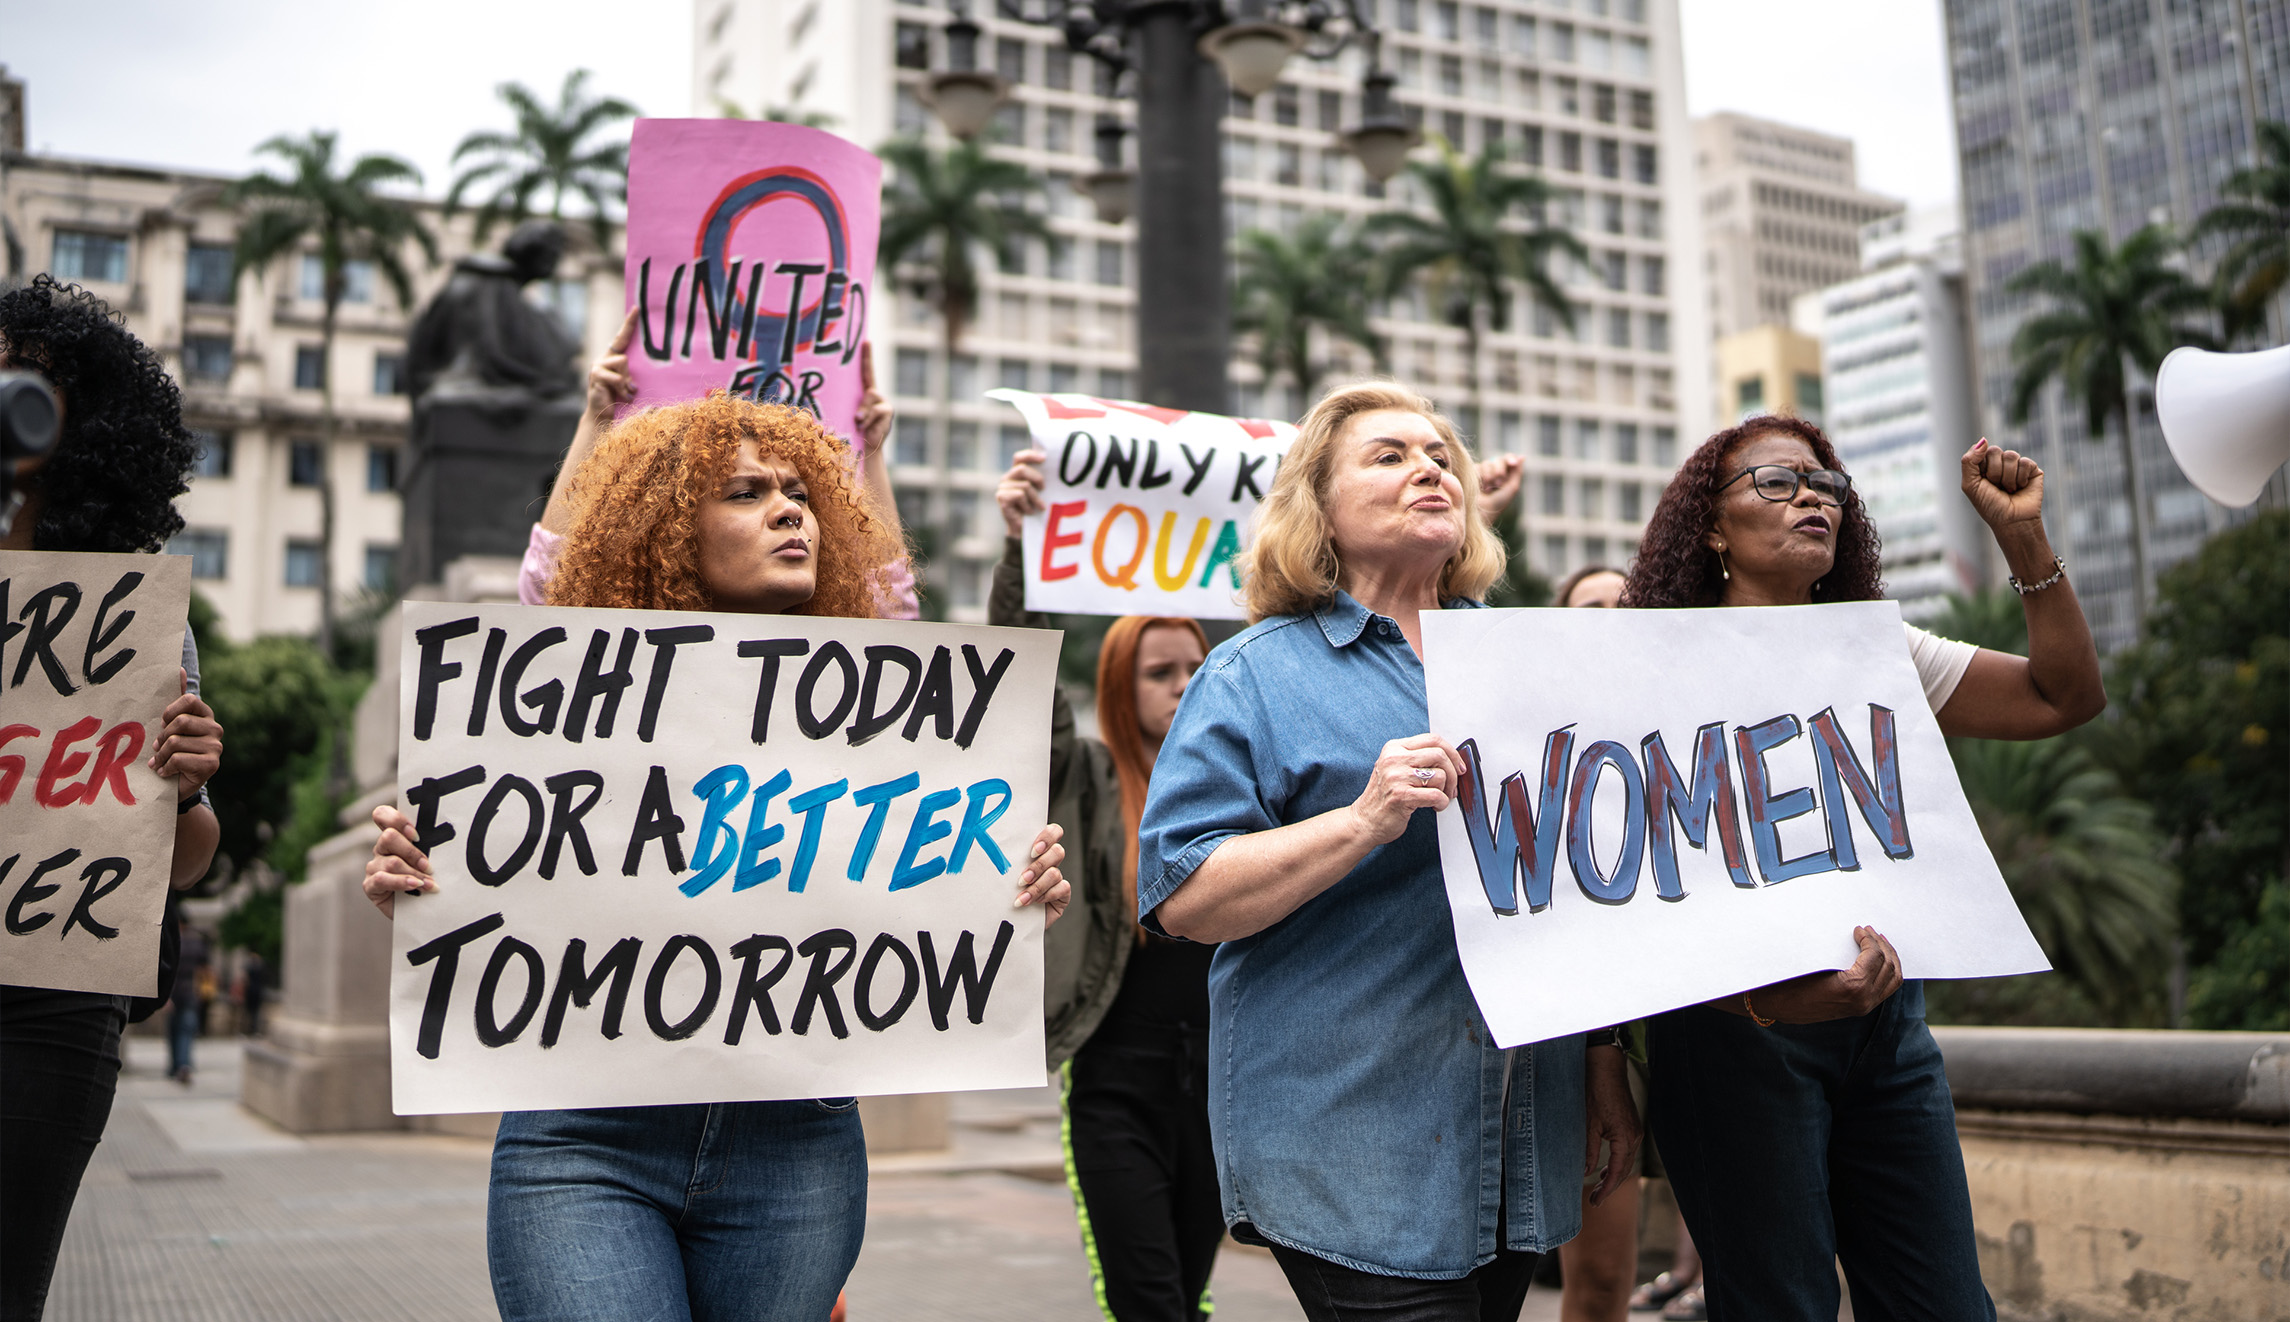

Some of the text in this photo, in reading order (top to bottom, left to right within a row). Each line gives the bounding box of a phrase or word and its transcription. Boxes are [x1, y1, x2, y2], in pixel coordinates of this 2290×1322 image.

[638, 255, 867, 366] UNITED
[728, 366, 825, 420] FOR
[1059, 431, 1217, 496] ONLY
[1040, 501, 1244, 592] EQUA
[414, 616, 1015, 750] FIGHT TODAY
[405, 764, 1013, 898] FOR A BETTER
[1457, 703, 1914, 919] WOMEN
[0, 848, 132, 942] ER
[407, 912, 1015, 1060] TOMORROW
